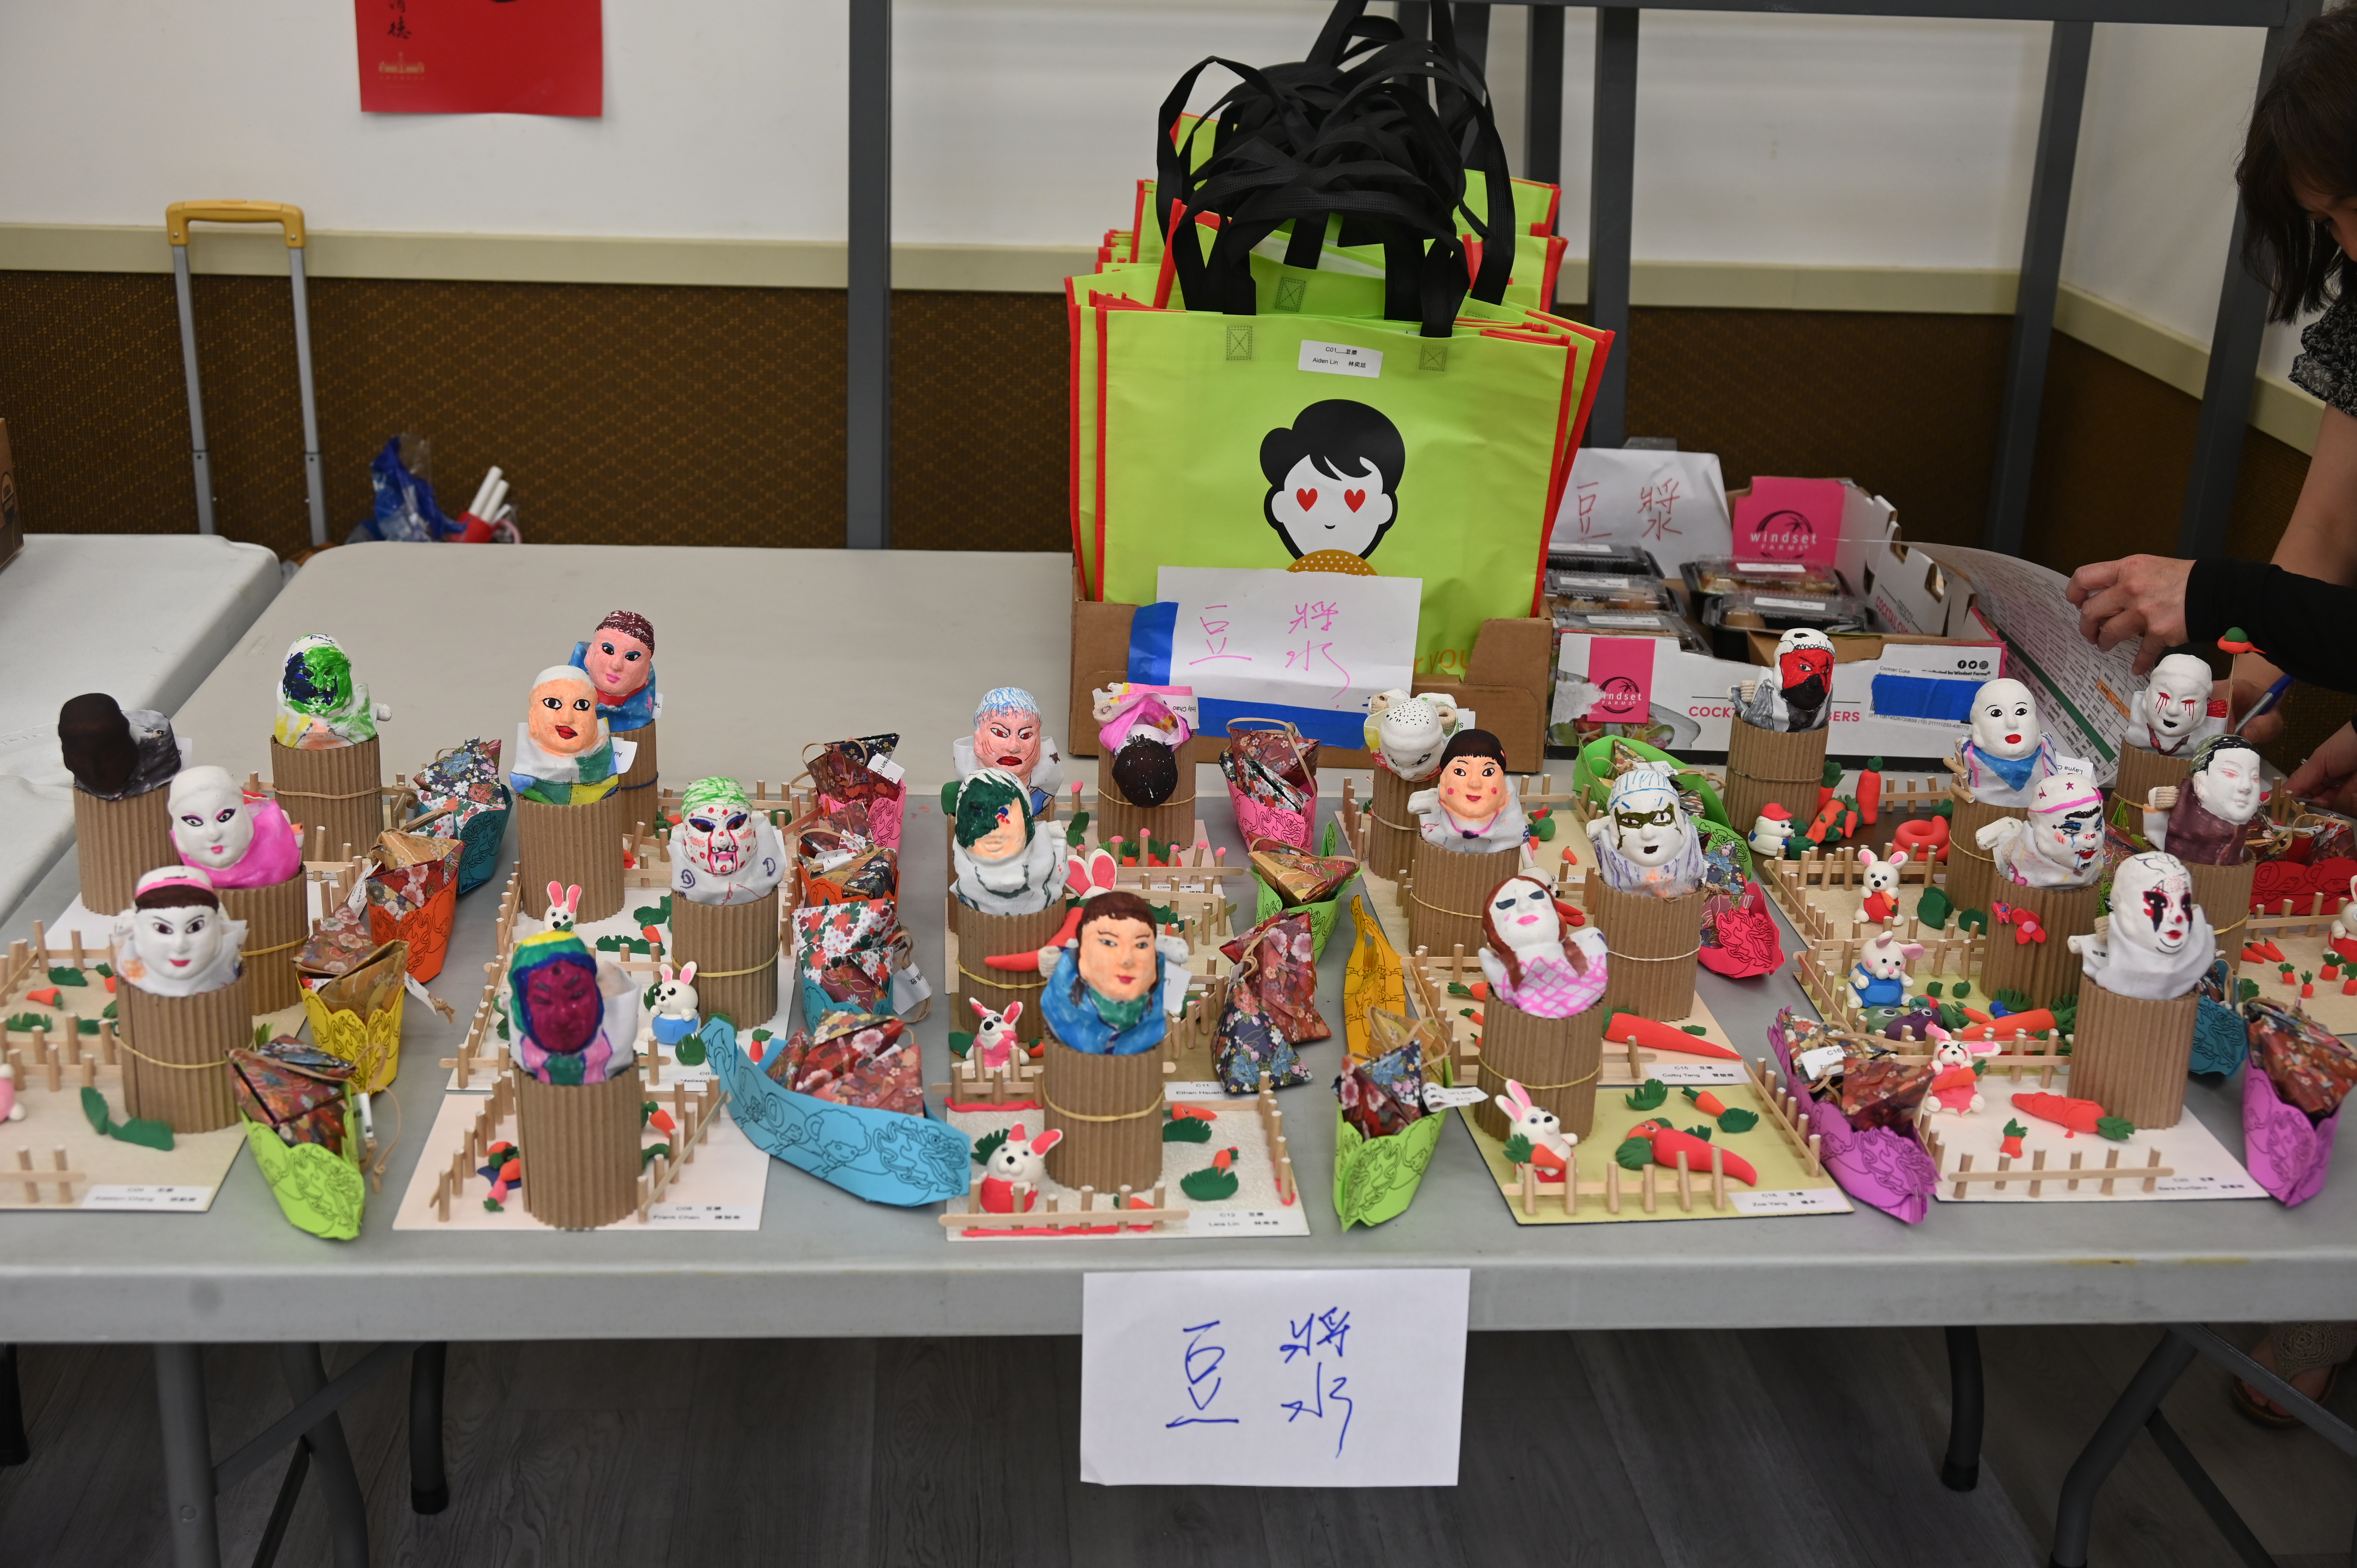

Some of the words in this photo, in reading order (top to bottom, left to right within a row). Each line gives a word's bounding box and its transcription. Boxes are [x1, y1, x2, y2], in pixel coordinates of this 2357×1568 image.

[1751, 530, 1817, 544] windset
[1876, 595, 1897, 629] COCKTAIL
[2062, 721, 2071, 730] Gender
[2065, 736, 2075, 745] Student
[2070, 731, 2080, 741] Chinese
[2074, 747, 2083, 757] Student
[2064, 765, 2083, 775] Layna
